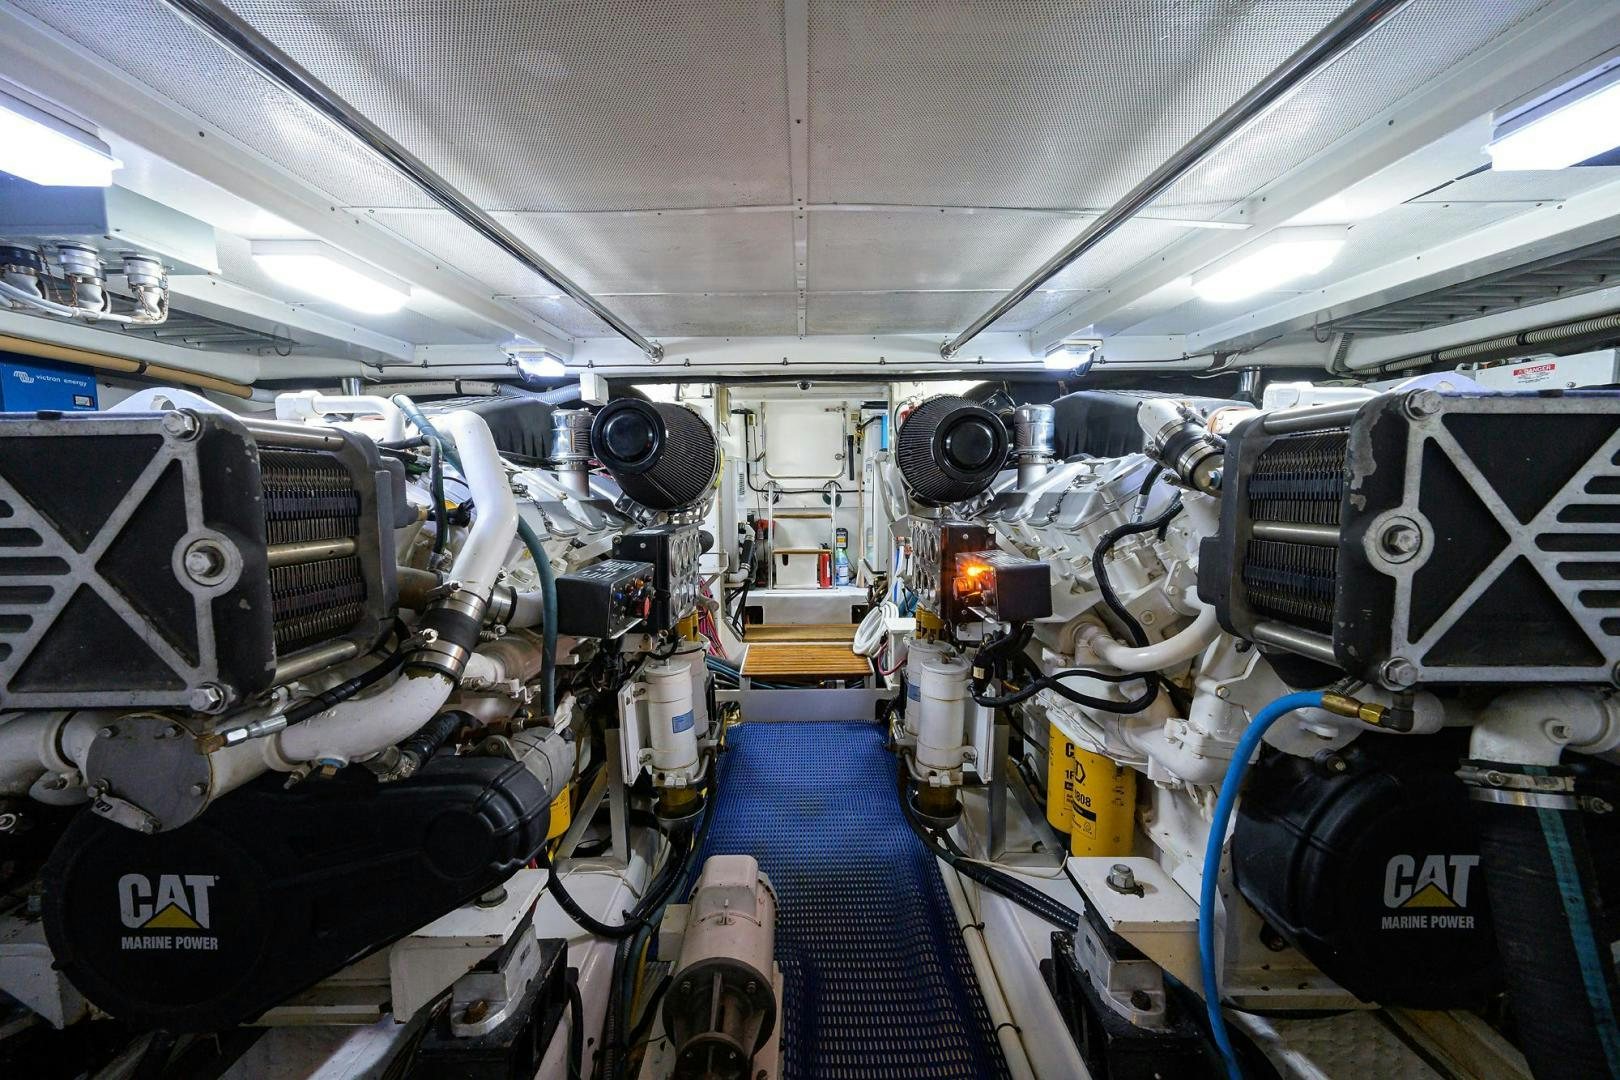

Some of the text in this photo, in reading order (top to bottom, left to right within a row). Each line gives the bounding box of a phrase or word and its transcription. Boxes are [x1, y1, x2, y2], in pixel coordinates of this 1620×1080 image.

[63, 378, 87, 388] energy
[1383, 854, 1480, 909] CAT
[118, 873, 216, 929] CAT
[1381, 915, 1475, 929] MARINE POWER
[121, 936, 219, 950] MARINE POWER
